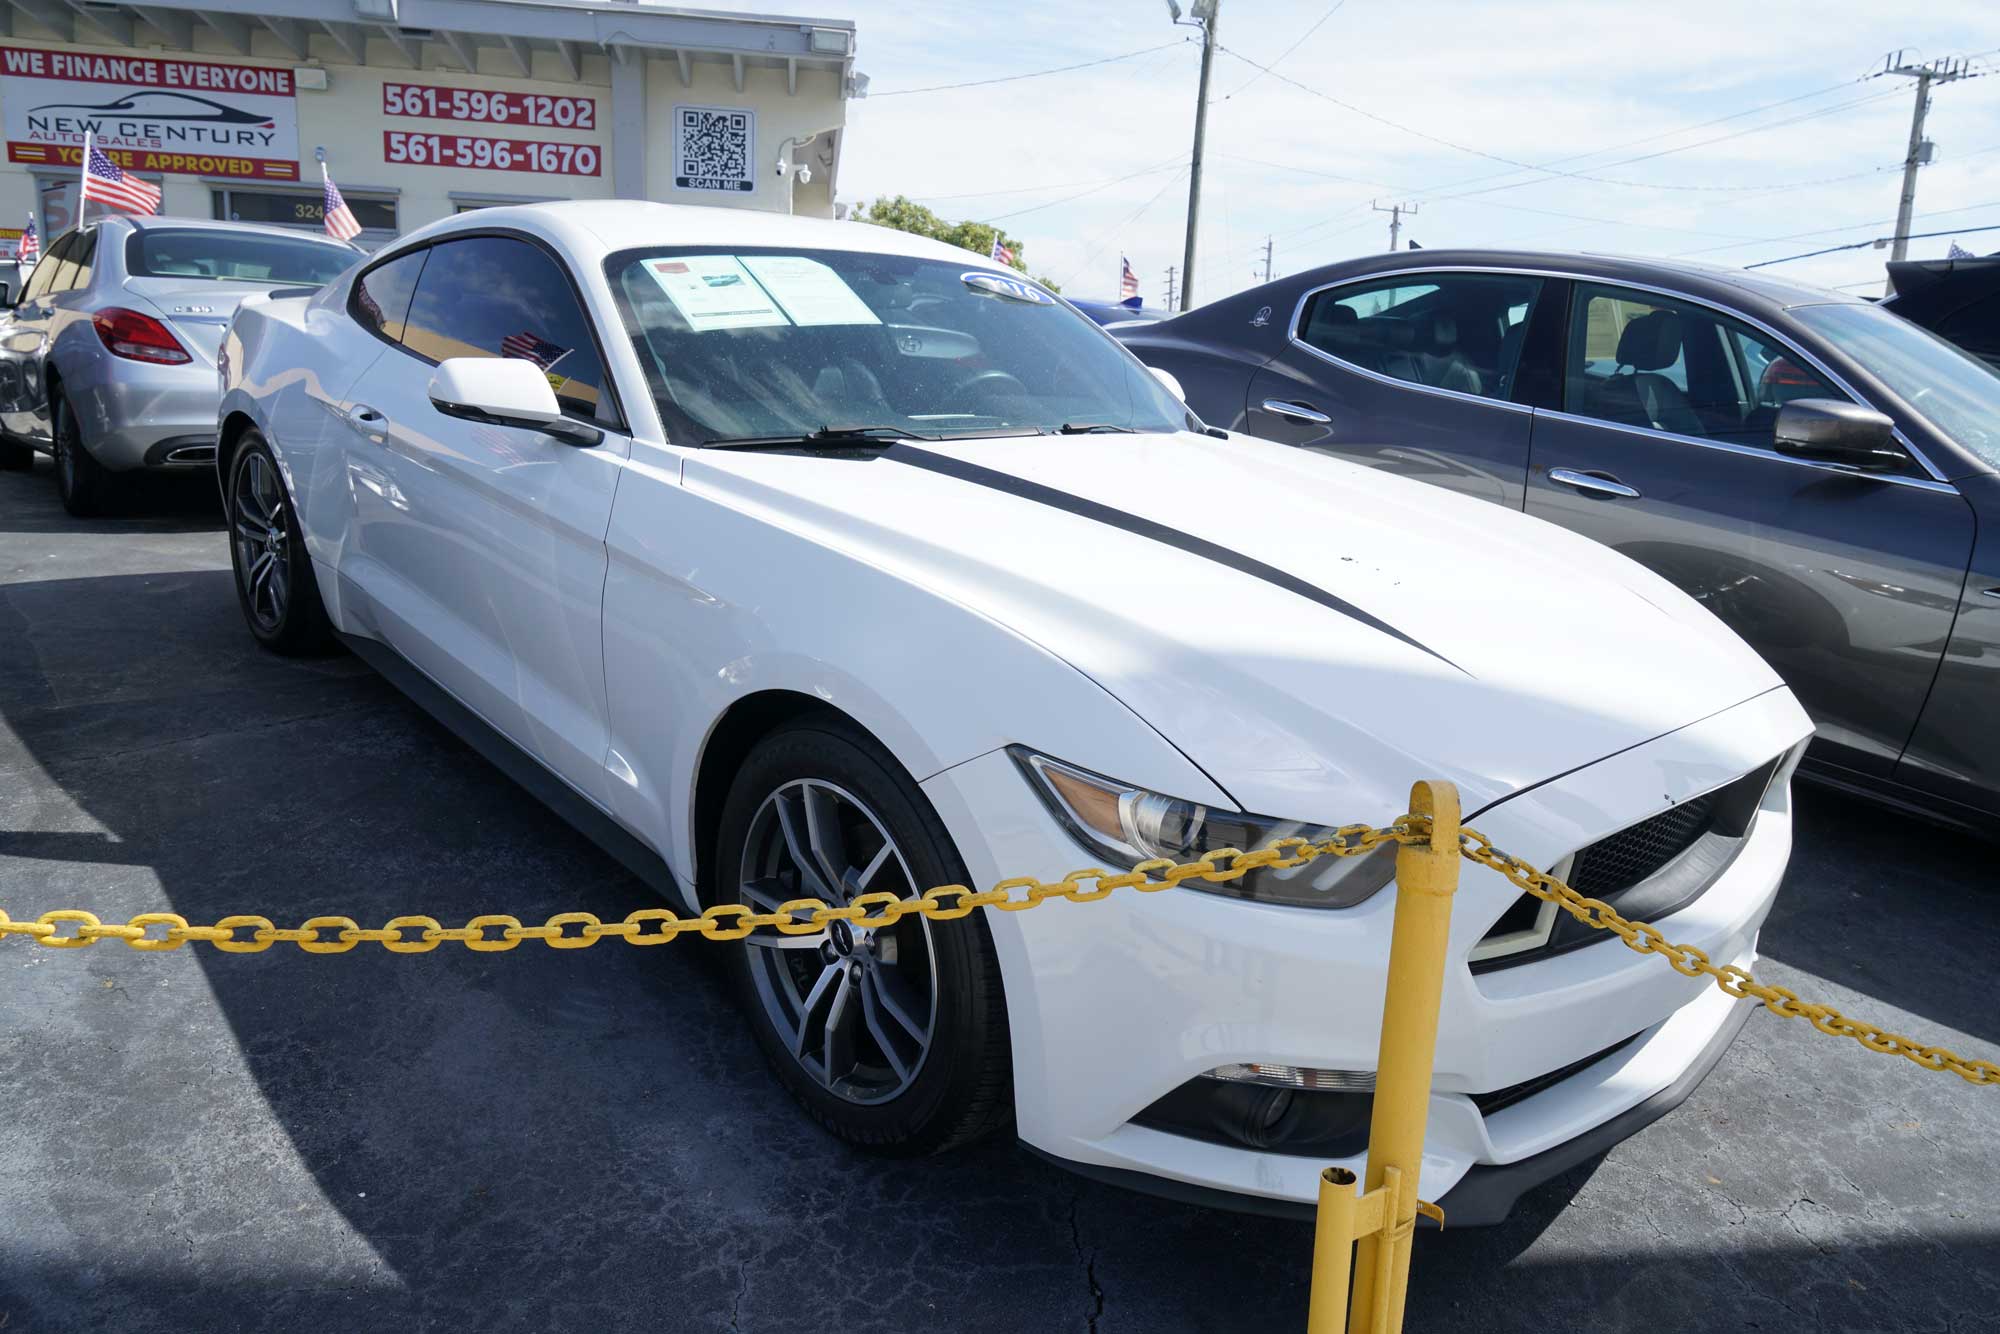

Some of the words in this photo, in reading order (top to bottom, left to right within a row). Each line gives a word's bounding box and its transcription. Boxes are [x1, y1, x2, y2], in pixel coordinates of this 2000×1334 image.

[5, 50, 45, 74] WE
[52, 54, 158, 83] FINANCE
[165, 64, 290, 93] EVERYONE
[385, 85, 592, 128] 561-596-1202
[28, 115, 102, 134] NEW
[119, 122, 276, 147] CENTURY
[29, 131, 86, 143] AUTO
[97, 135, 163, 148] SALES
[145, 155, 254, 175] APPROVED
[390, 133, 596, 174] 561-596-1670
[688, 178, 720, 189] SCAN
[723, 180, 741, 190] ME
